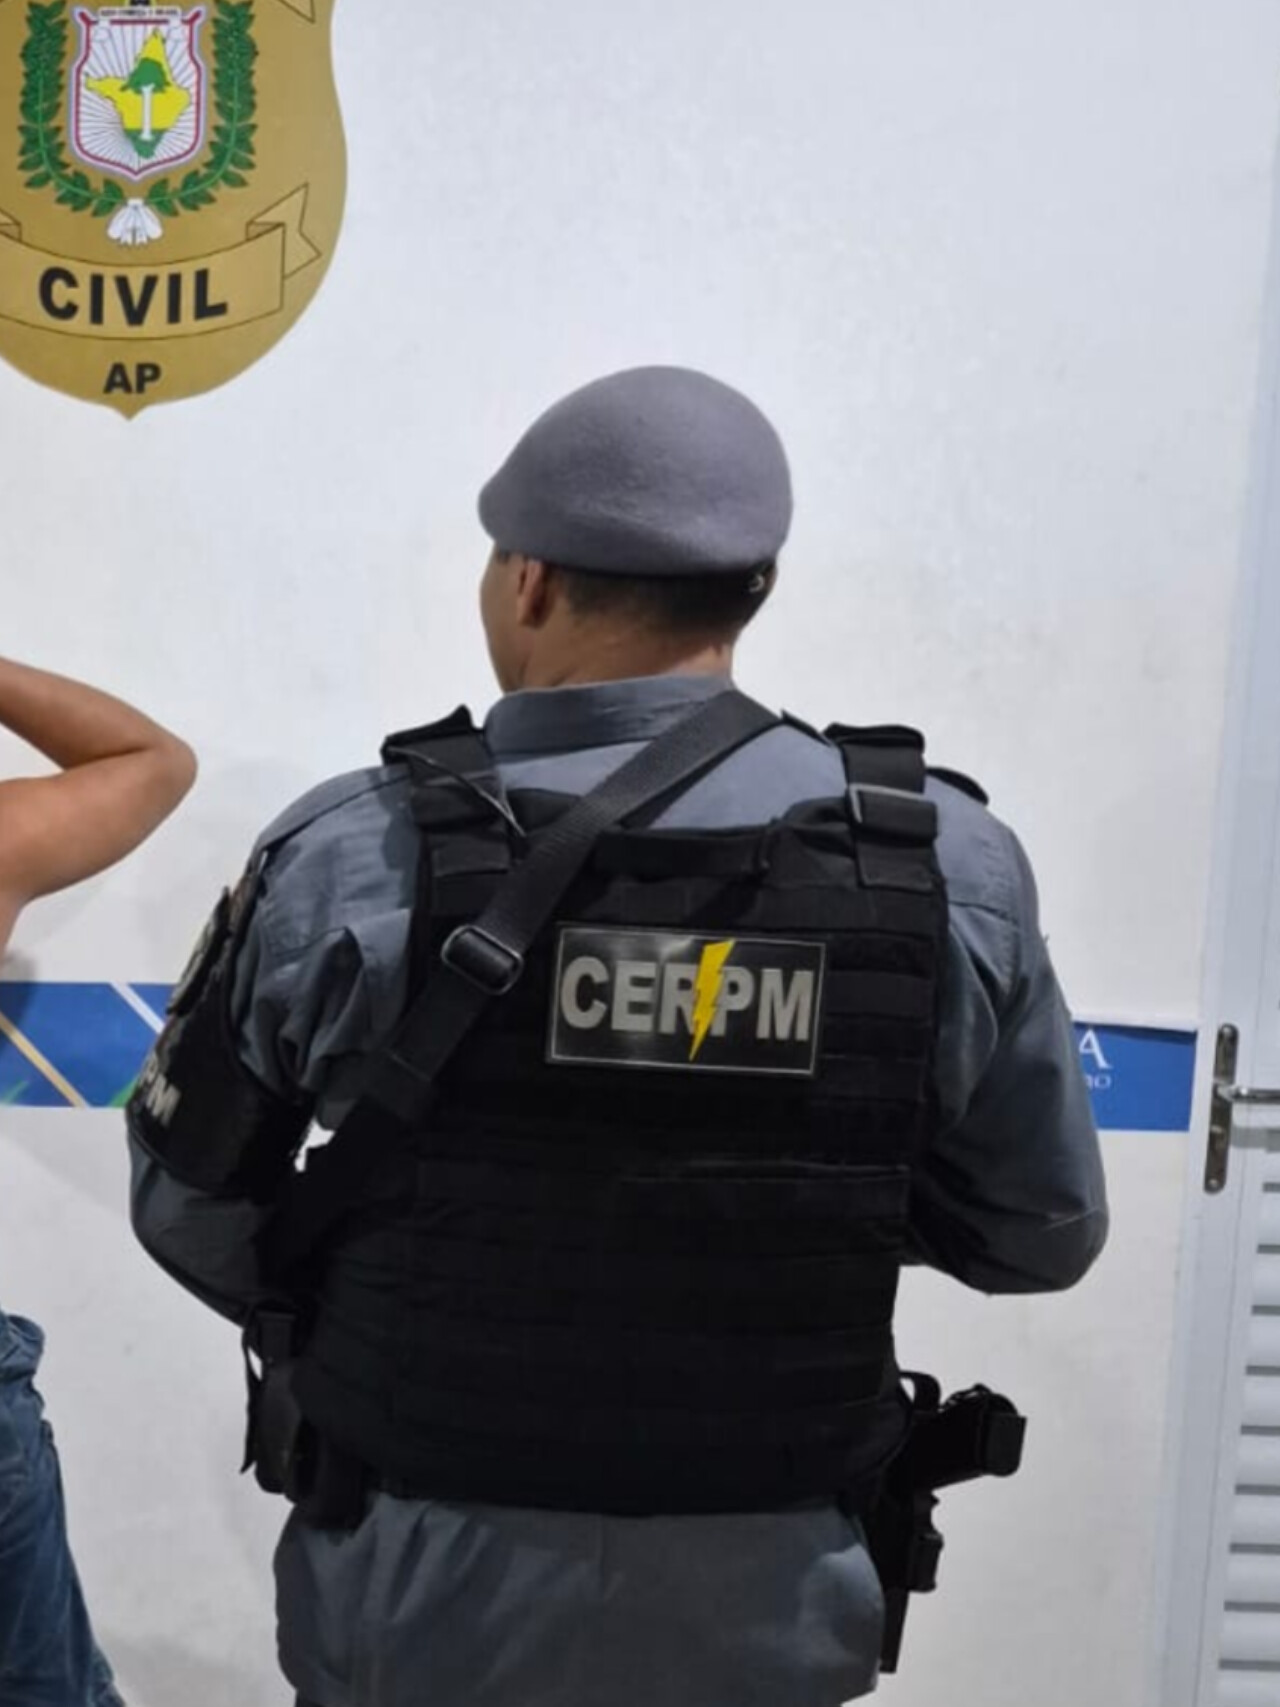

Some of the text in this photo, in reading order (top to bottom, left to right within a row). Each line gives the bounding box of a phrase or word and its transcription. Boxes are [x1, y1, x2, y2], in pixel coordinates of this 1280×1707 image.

[38, 267, 228, 326] CIVIL
[103, 363, 161, 394] AP
[560, 955, 815, 1041] CERPM
